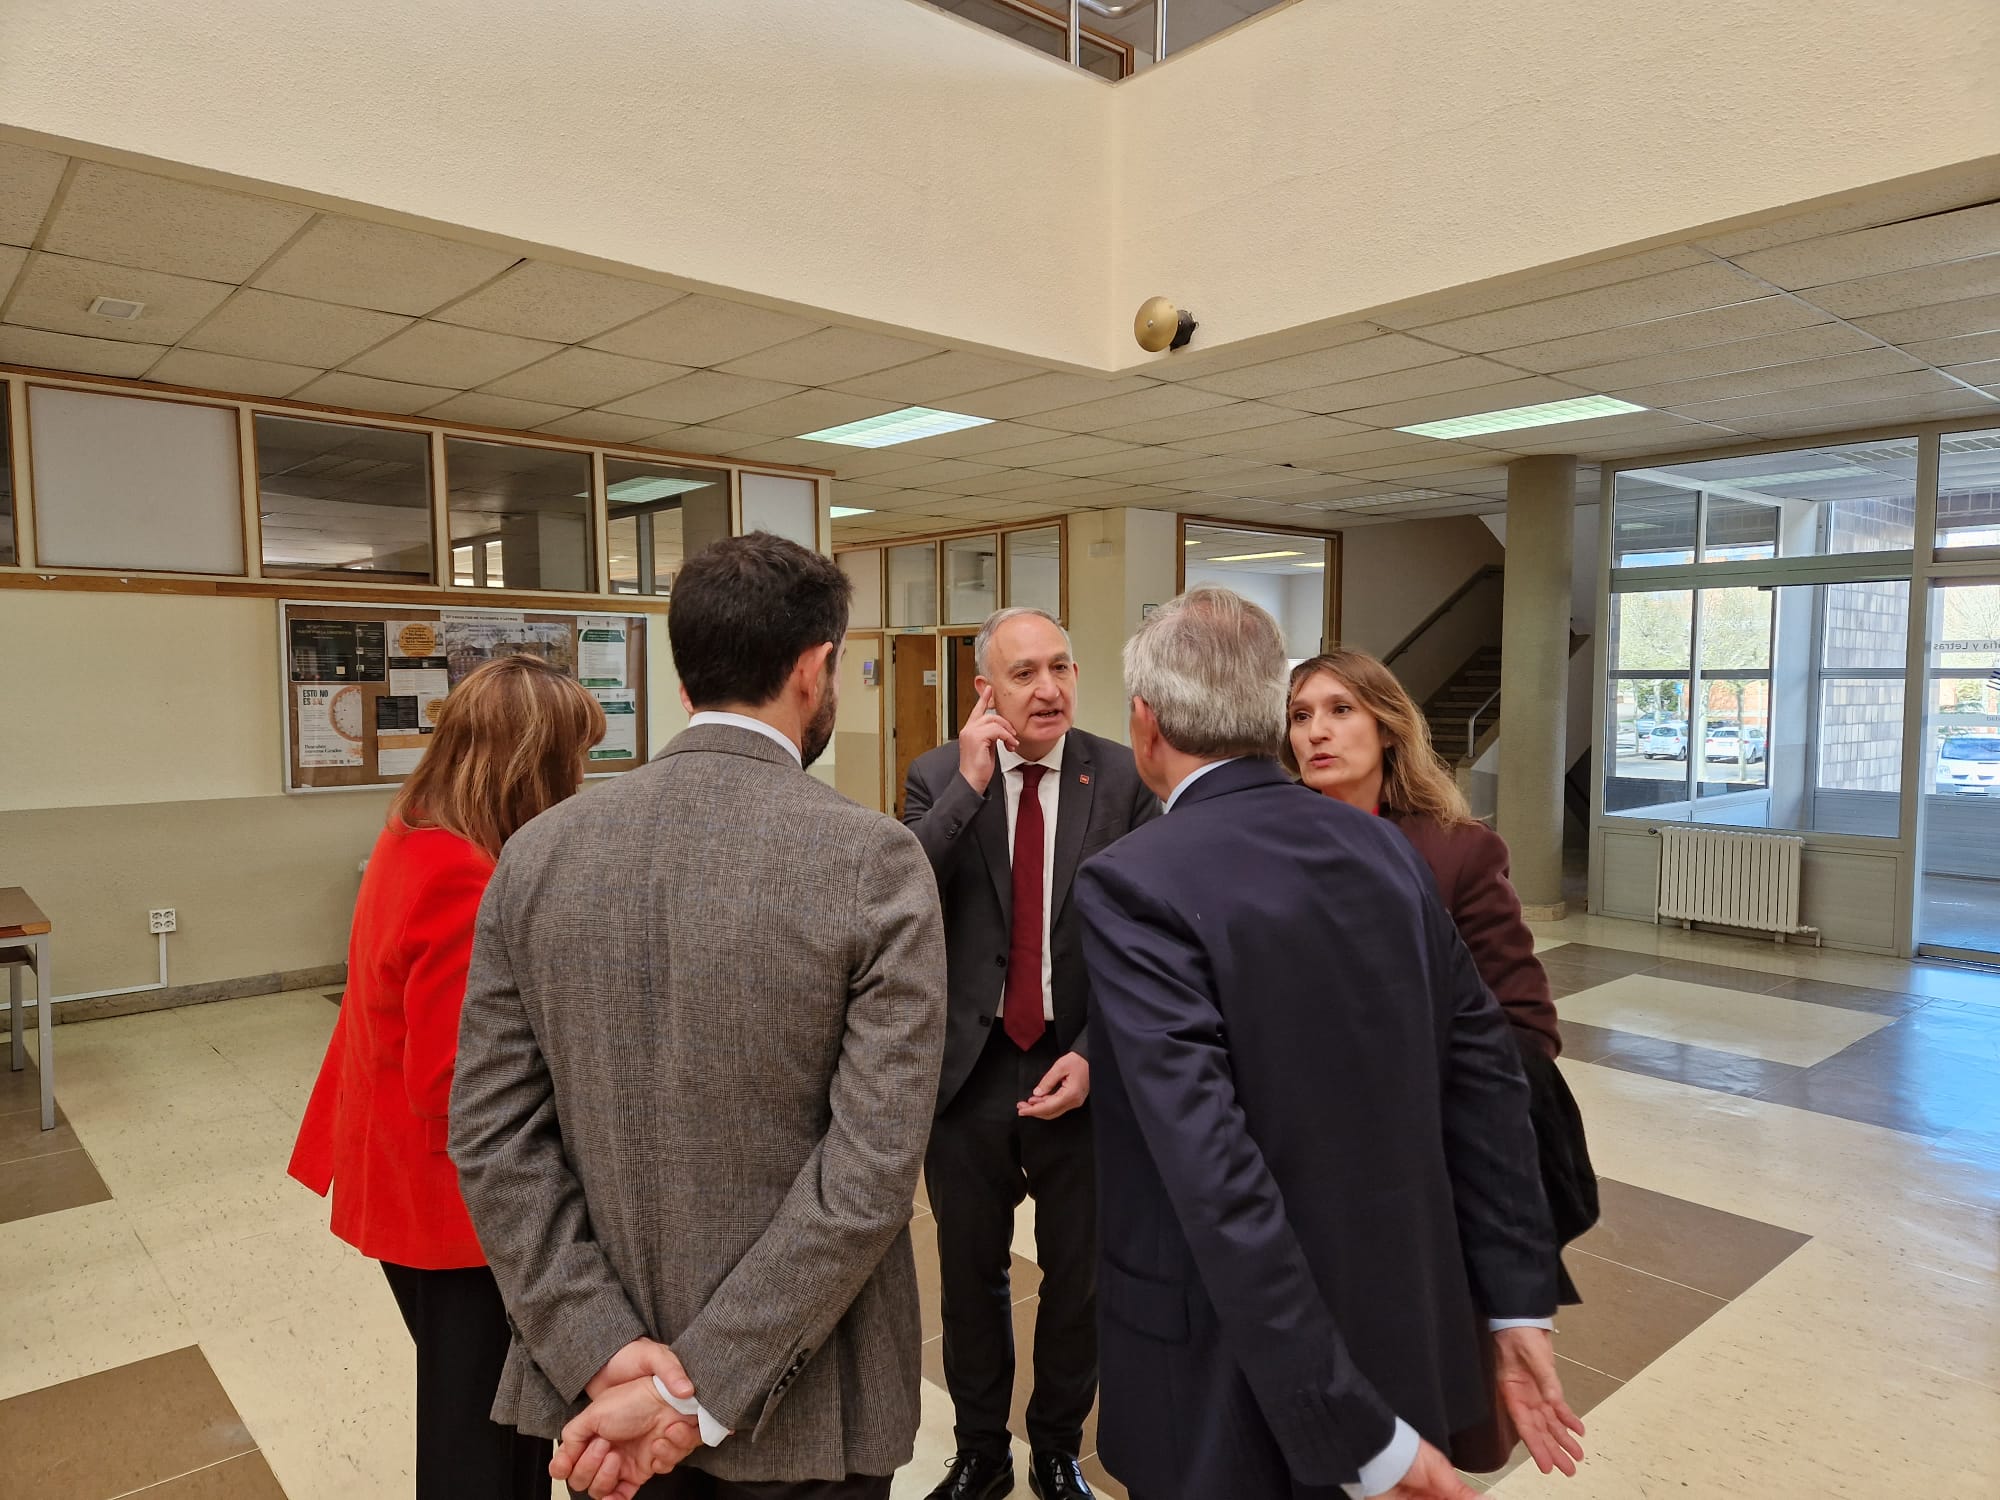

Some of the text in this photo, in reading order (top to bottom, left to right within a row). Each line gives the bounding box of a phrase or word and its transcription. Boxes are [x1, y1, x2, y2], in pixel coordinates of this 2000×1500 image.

[303, 689, 329, 698] ESTO NO
[303, 698, 311, 706] ES
